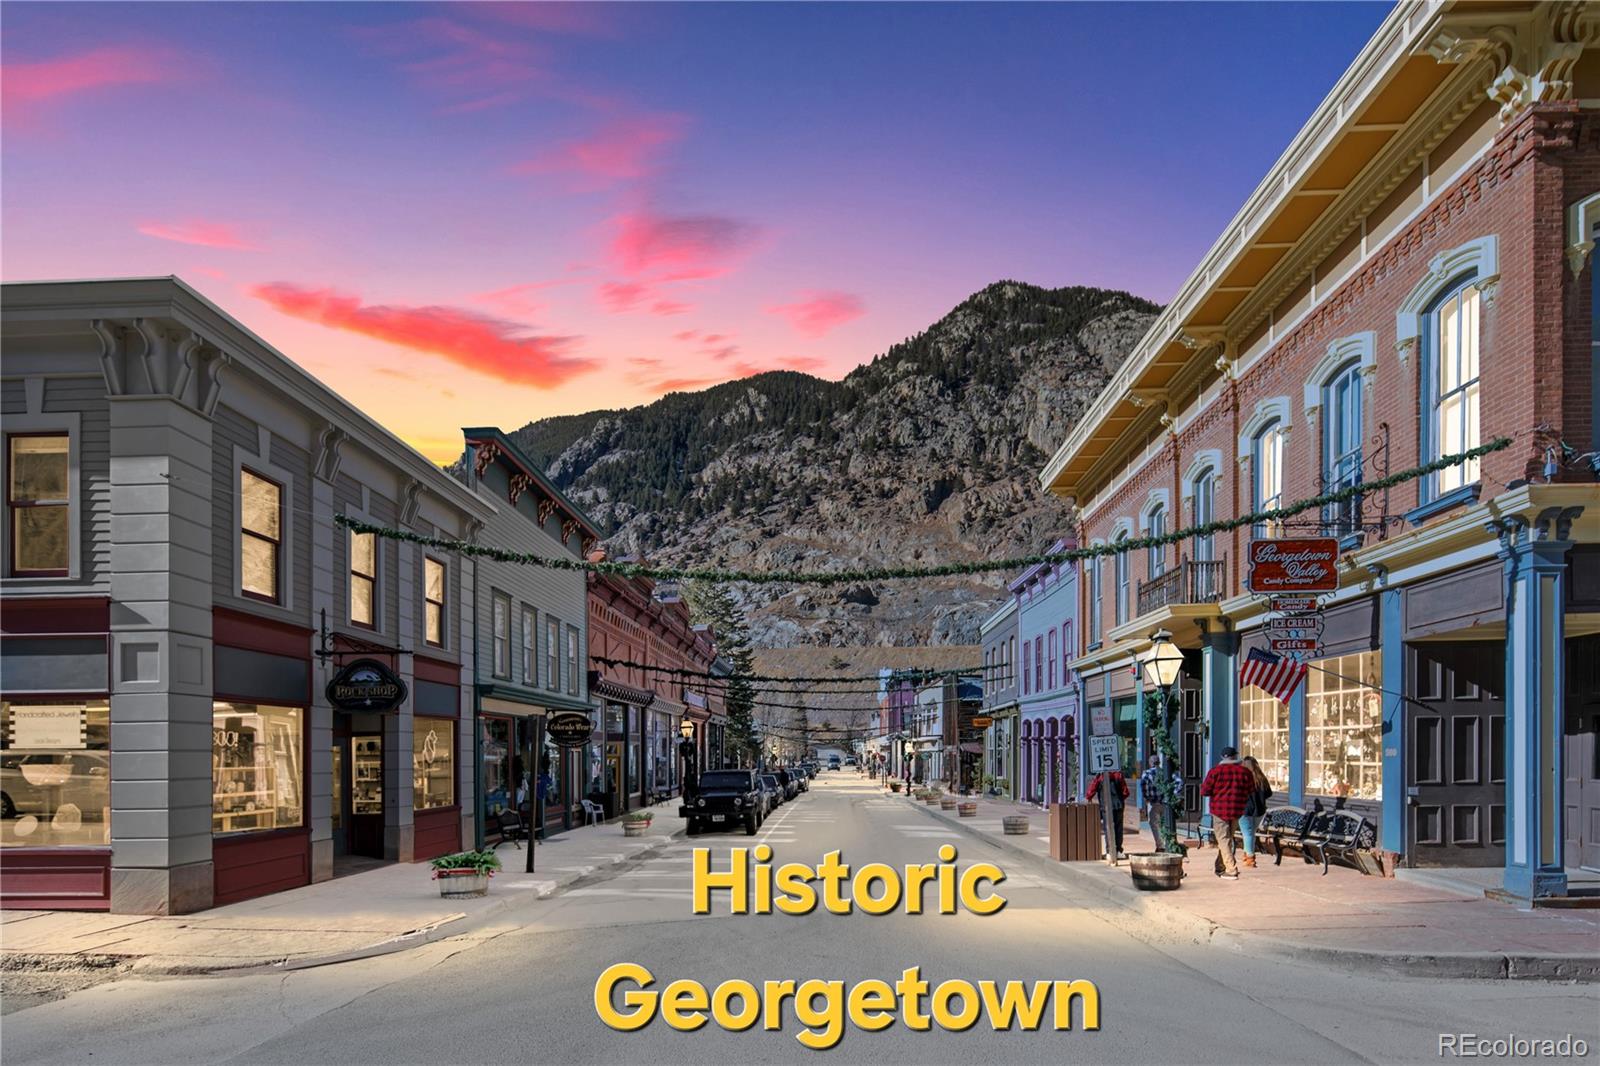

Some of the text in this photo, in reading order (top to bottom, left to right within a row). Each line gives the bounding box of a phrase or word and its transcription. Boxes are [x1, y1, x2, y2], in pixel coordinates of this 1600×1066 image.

[1255, 543, 1331, 568] Georgetown
[1279, 602, 1309, 610] Candy
[1274, 619, 1314, 628] ICE CREAM
[1276, 640, 1308, 649] Gifts
[336, 684, 398, 699] ROCK SHOP
[1096, 754, 1114, 768] 15
